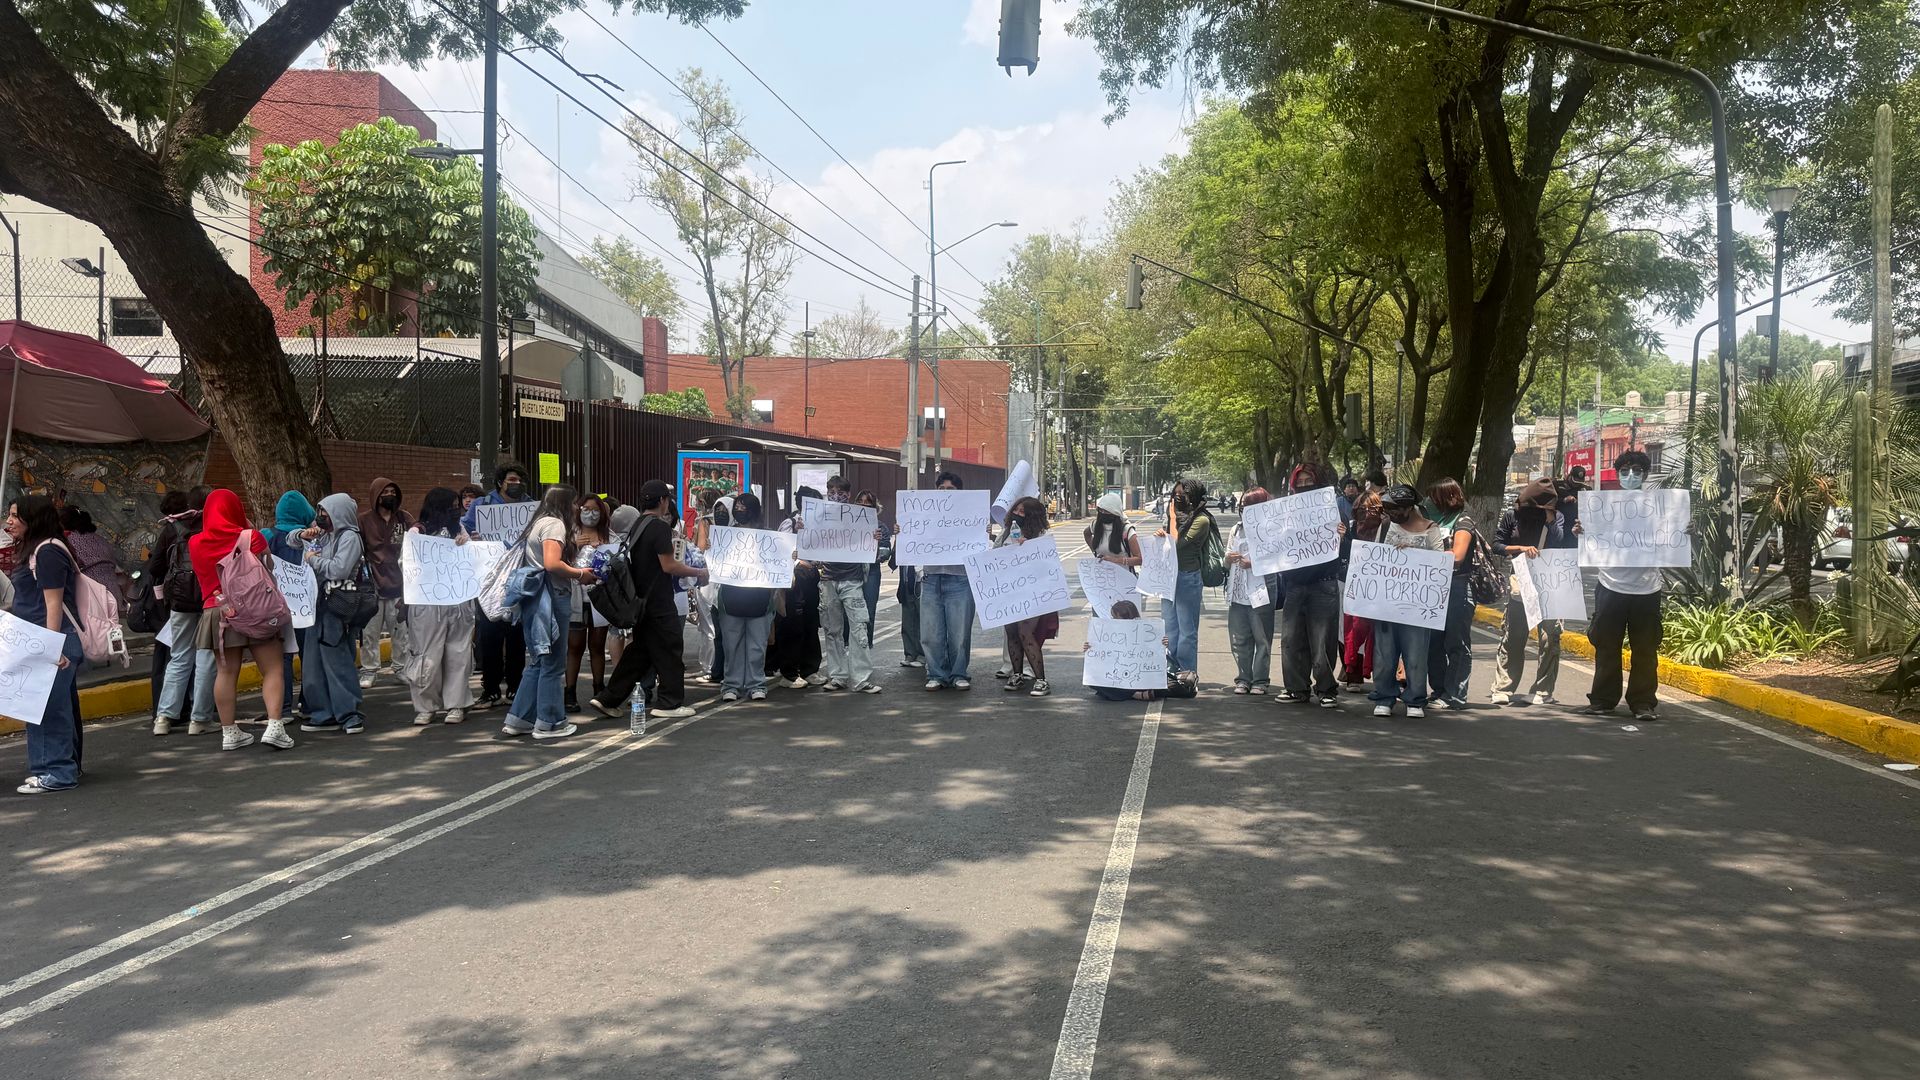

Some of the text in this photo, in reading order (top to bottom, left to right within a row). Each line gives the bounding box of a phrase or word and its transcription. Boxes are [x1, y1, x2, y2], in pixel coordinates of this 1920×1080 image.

[522, 402, 539, 414] PUERTA
[540, 404, 545, 415] DE
[545, 404, 561, 416] ACCESO
[804, 500, 870, 525] FUERA
[712, 528, 733, 549] NO
[801, 528, 876, 553] CORRUPCION
[1295, 522, 1335, 545] REYES
[905, 538, 987, 555] acosadores
[1360, 543, 1408, 566] SOMOS
[984, 557, 1008, 574] mis
[1361, 562, 1449, 587] ESTUDIANTES
[975, 574, 1037, 601] Rateros
[1092, 623, 1157, 646] Voca 13
